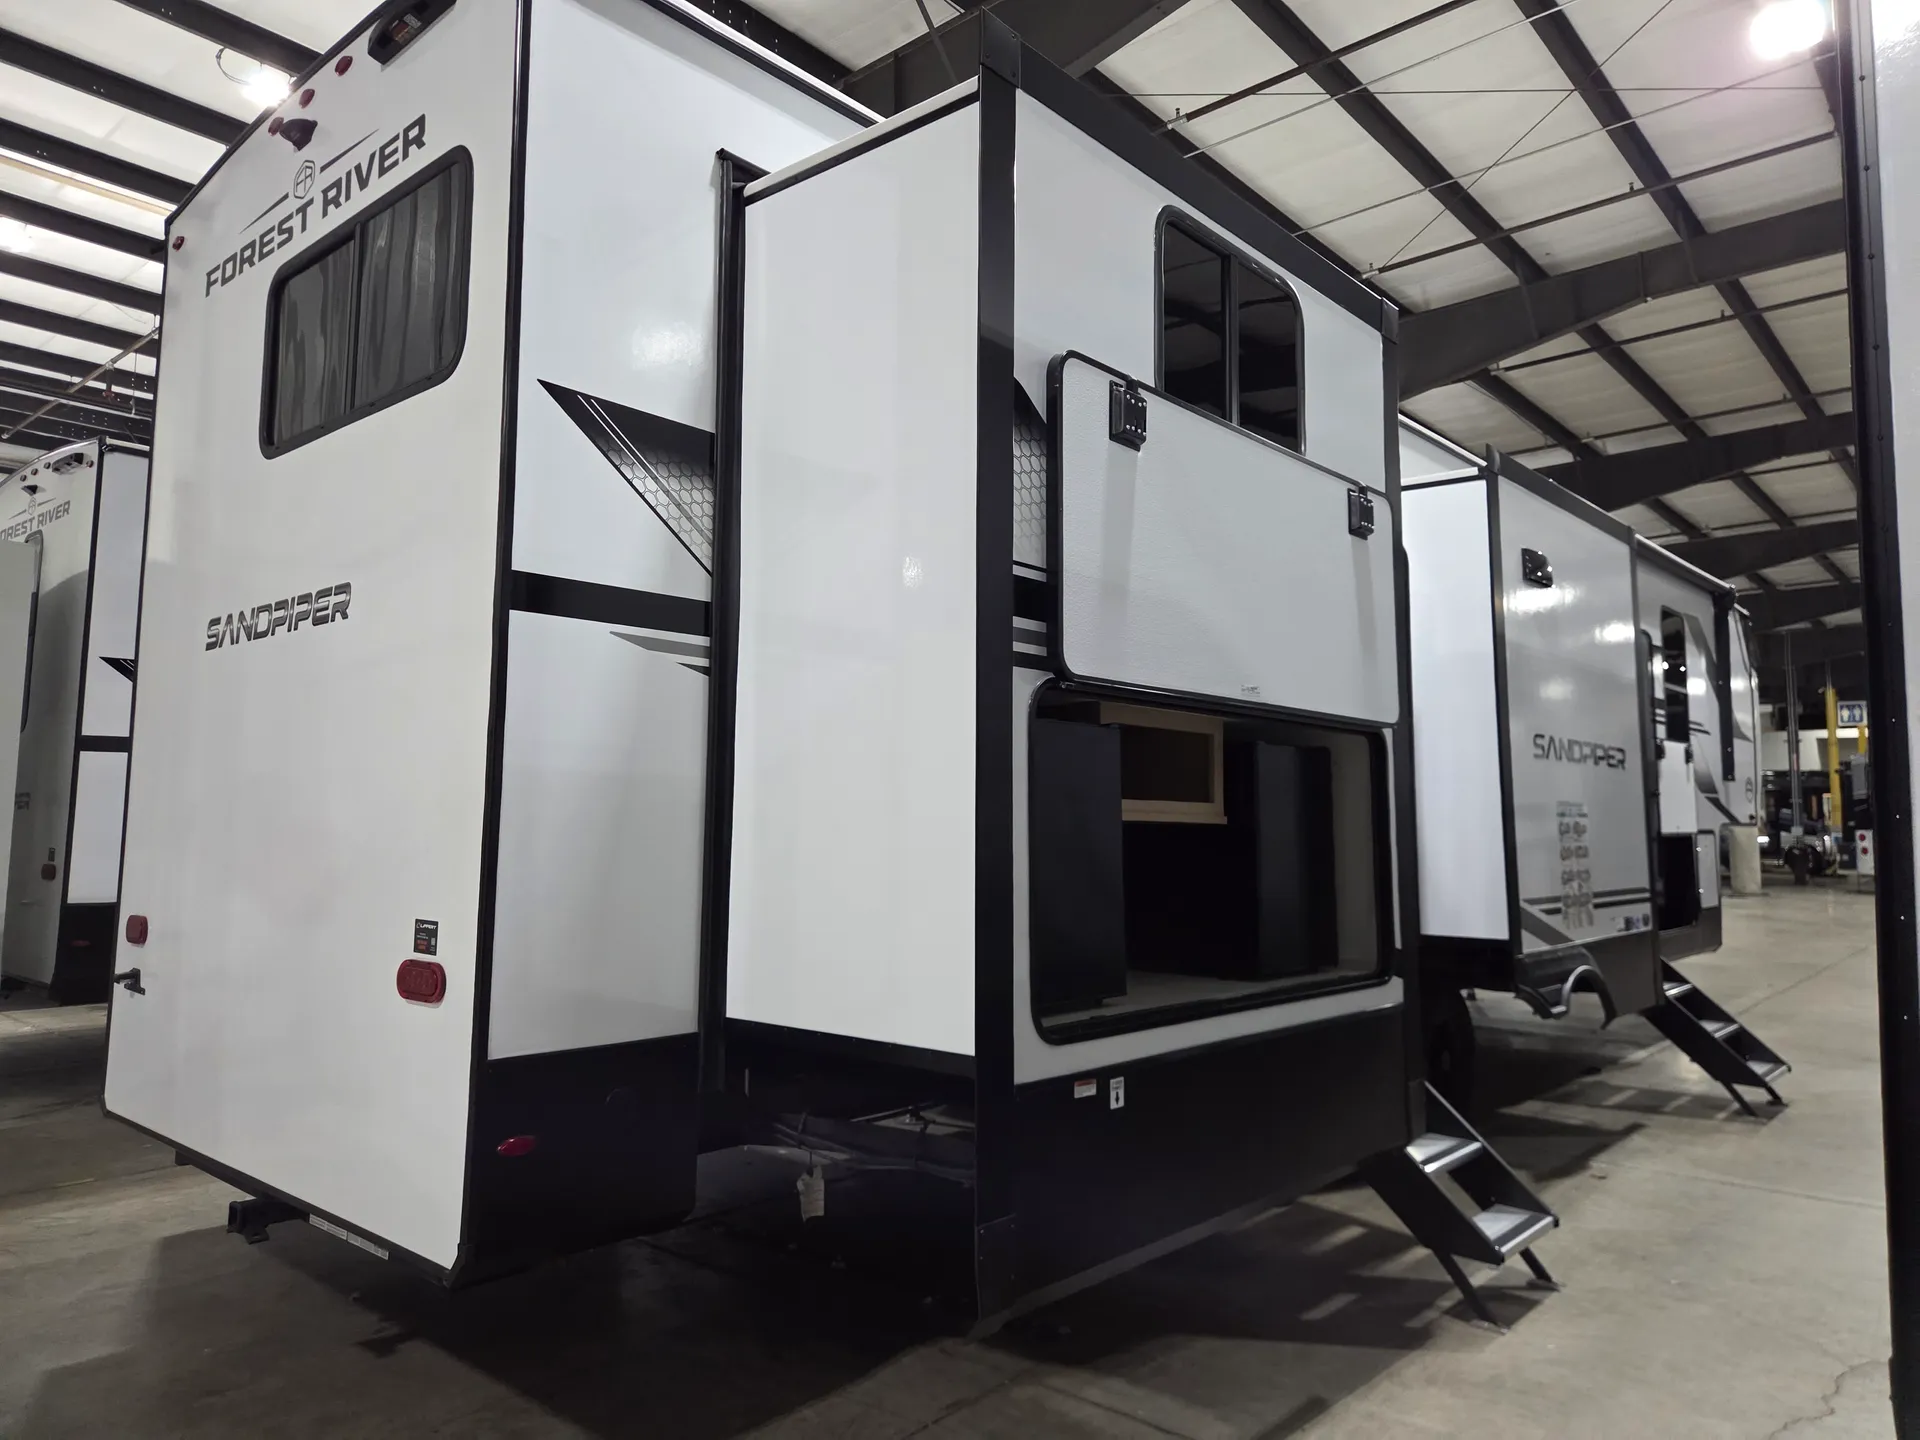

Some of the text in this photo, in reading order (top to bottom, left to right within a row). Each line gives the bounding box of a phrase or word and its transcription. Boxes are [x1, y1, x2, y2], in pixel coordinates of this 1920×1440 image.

[205, 113, 426, 298] FOREST RIVER
[0, 516, 35, 540] OREST
[37, 500, 70, 528] RIVER
[205, 581, 351, 651] SANDPIPER
[1533, 733, 1626, 771] SANDPIPER
